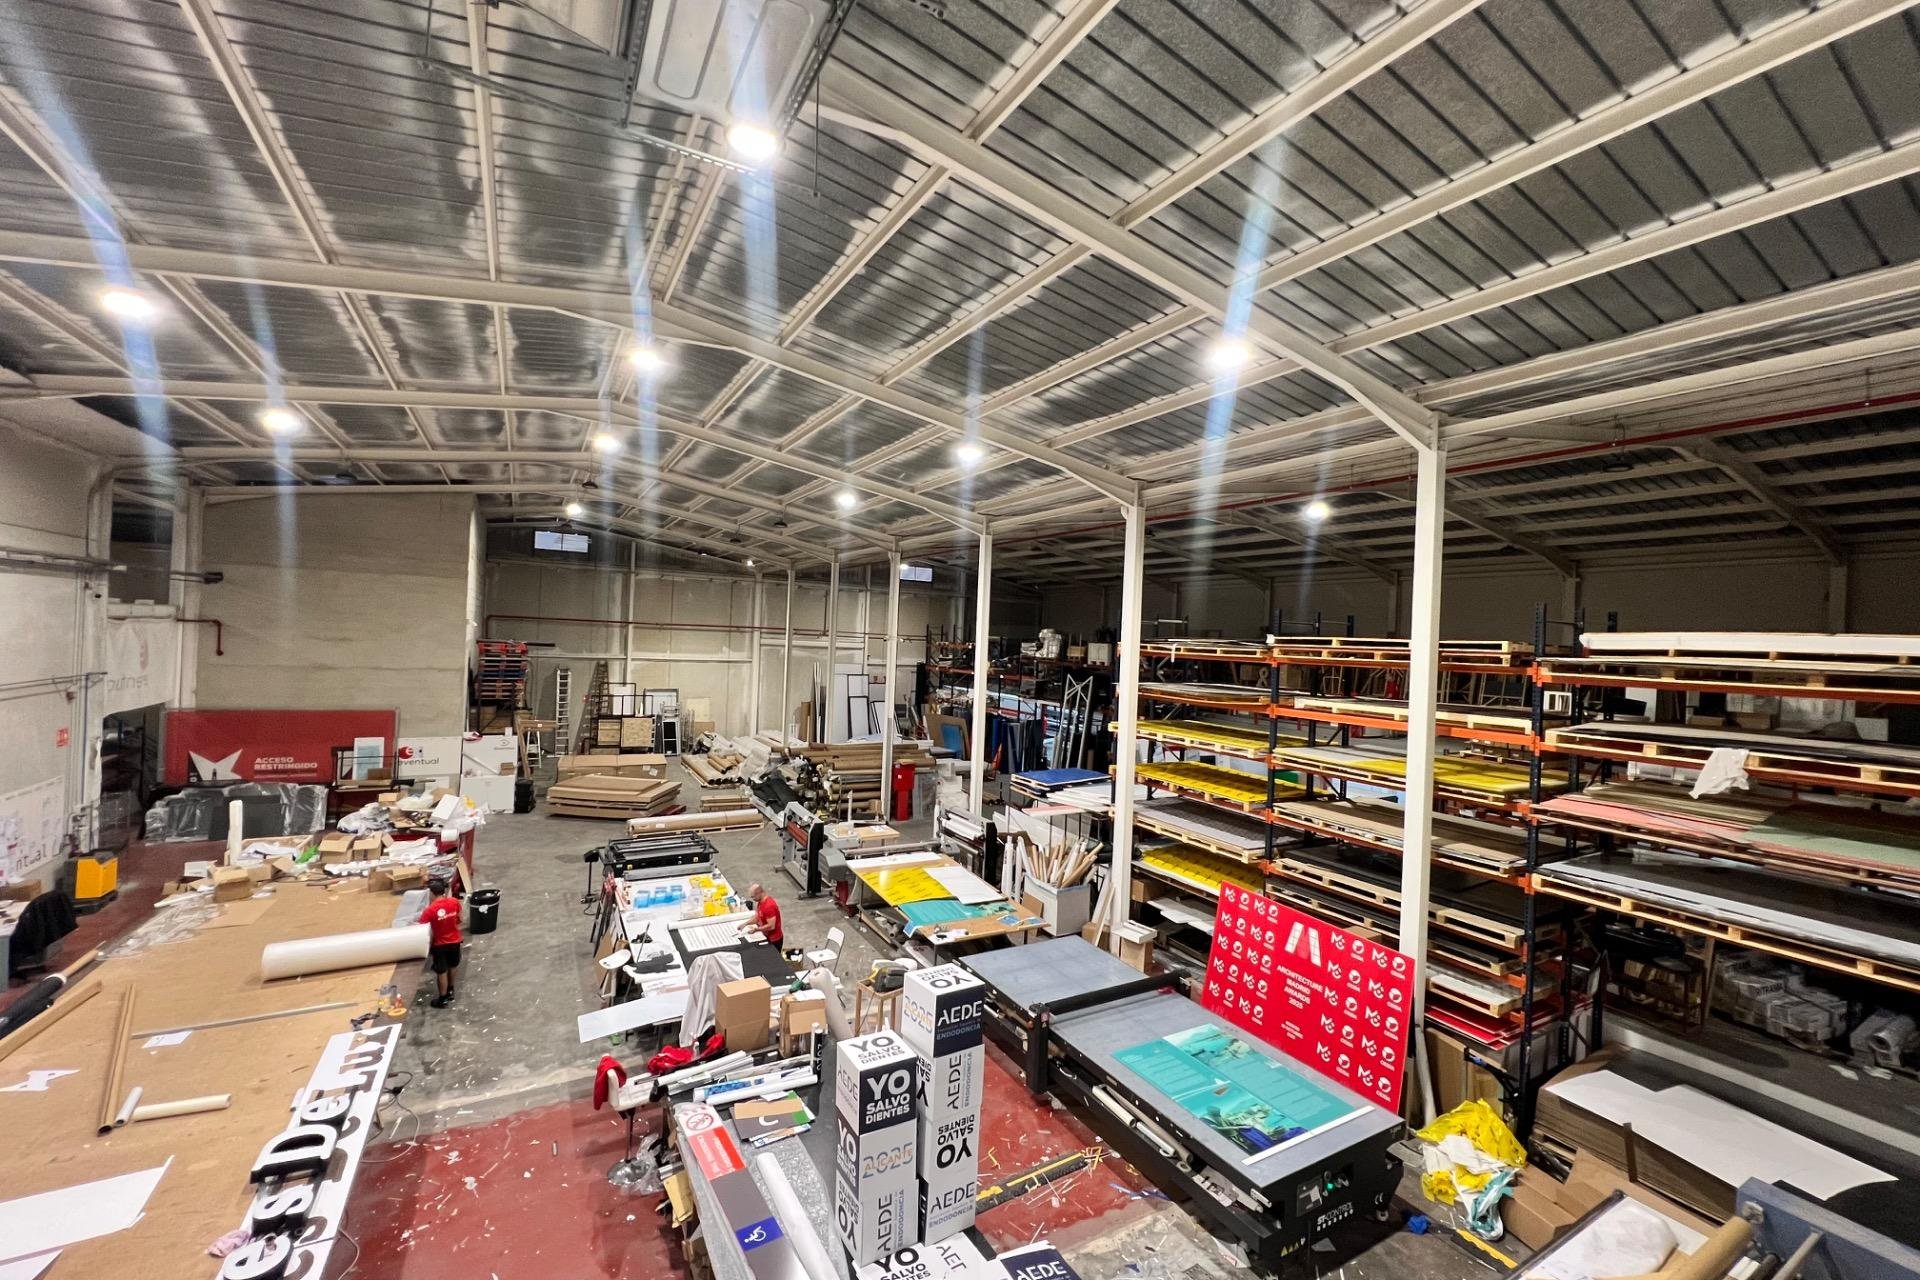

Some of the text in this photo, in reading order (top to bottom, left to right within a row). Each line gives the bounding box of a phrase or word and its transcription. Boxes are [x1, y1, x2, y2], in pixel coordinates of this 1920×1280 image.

[254, 762, 318, 770] RESTRINGIDO
[398, 758, 440, 766] eventual
[930, 975, 972, 988] YO
[1276, 965, 1323, 992] ARCHITECTURE
[1286, 978, 1310, 995] MADRID
[1284, 986, 1310, 1004] AWARDS
[938, 1000, 983, 1027] AEDE
[936, 1022, 981, 1040] ENDODONCIA
[849, 1036, 895, 1052] YO
[858, 1045, 901, 1060] SALVO
[860, 1050, 905, 1064] DIENTES
[838, 1065, 858, 1102] AEDE
[866, 1069, 911, 1101] YO
[947, 1054, 962, 1110] AEDE
[866, 1093, 910, 1115] SALVO
[866, 1104, 910, 1124] DIENTES
[938, 1114, 974, 1135] DIENTES
[938, 1123, 974, 1146] SALVO
[838, 1118, 857, 1162] YO
[862, 1142, 914, 1179] 2025
[864, 1148, 914, 1172] ALICANTE
[936, 1138, 972, 1168] YO
[930, 1182, 975, 1214] AEDE
[838, 1205, 858, 1250] YO
[878, 1194, 892, 1252] AEDE
[928, 1205, 974, 1228] ENDODONCIA
[873, 1247, 920, 1273] YO
[1016, 1260, 1068, 1280] AEDE
